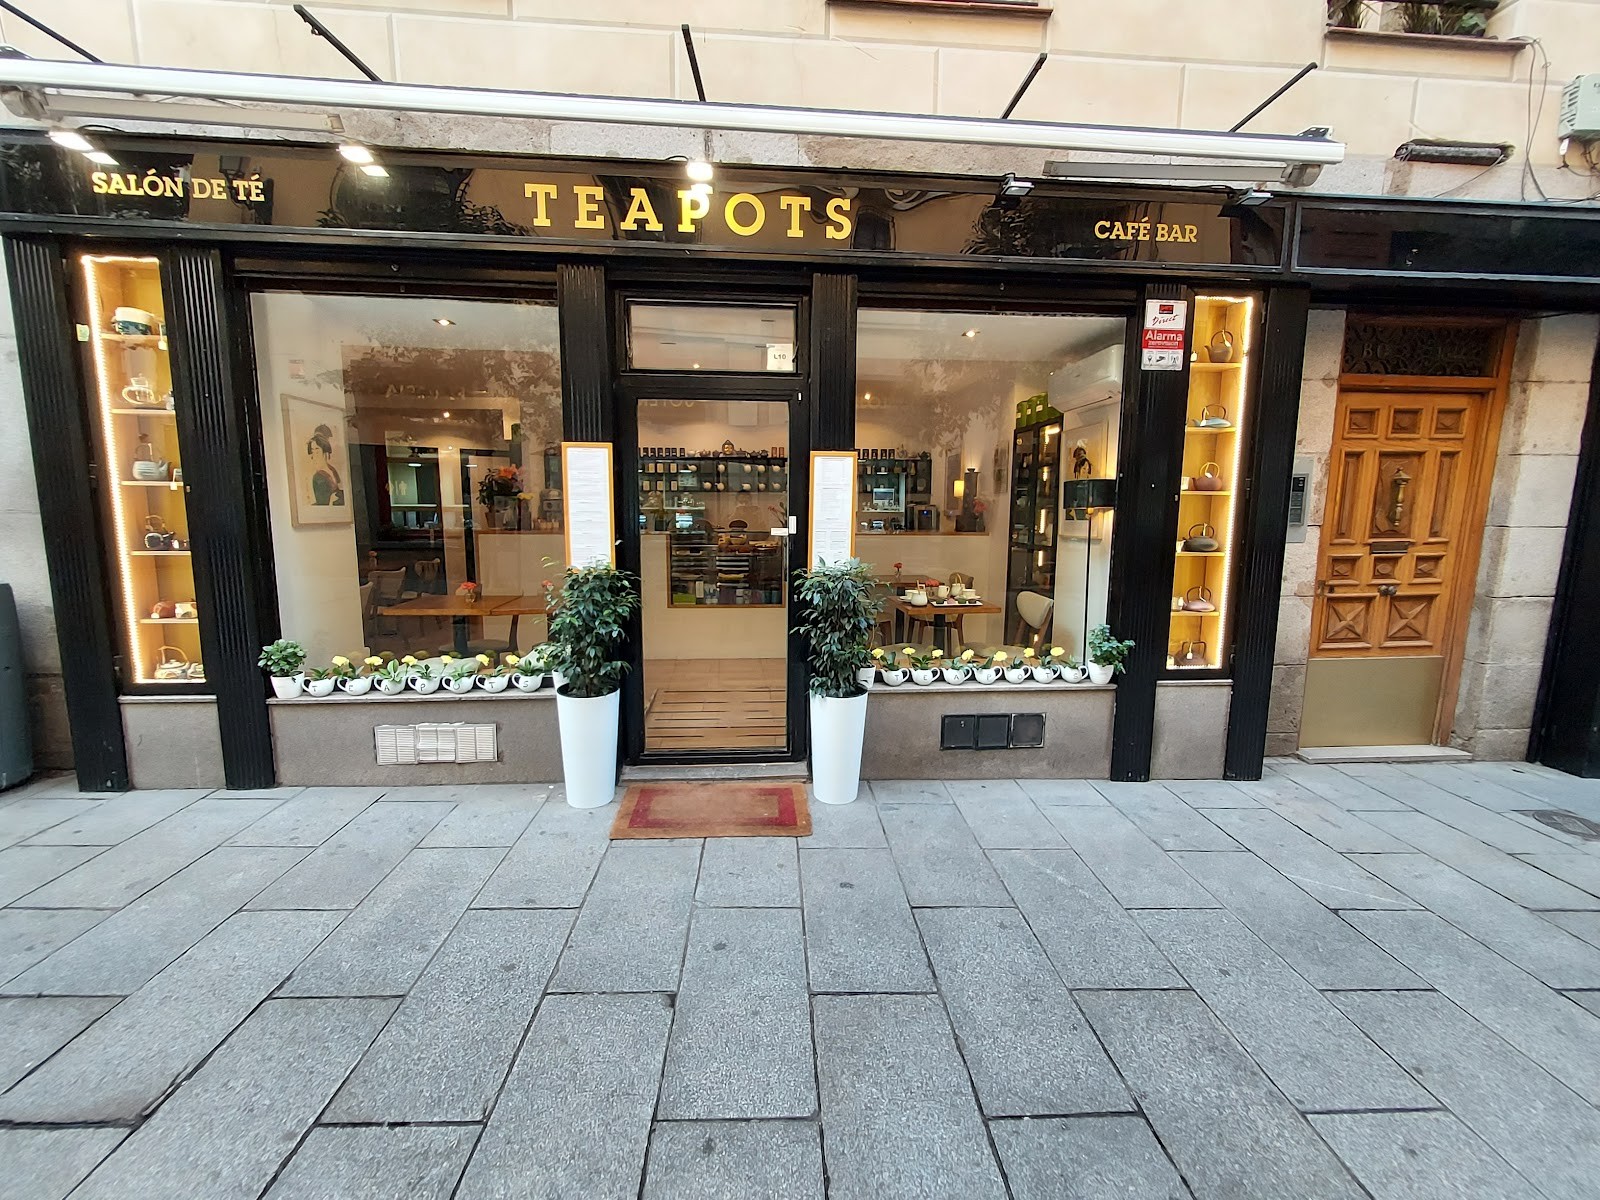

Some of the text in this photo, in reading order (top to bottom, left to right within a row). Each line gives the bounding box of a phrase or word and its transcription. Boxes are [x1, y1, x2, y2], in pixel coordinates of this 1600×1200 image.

[92, 168, 265, 202] SALÓN DE TÉ
[524, 182, 853, 240] TEAPOTS
[1094, 216, 1198, 243] CAFÉ BAR
[1145, 330, 1183, 341] Alarma
